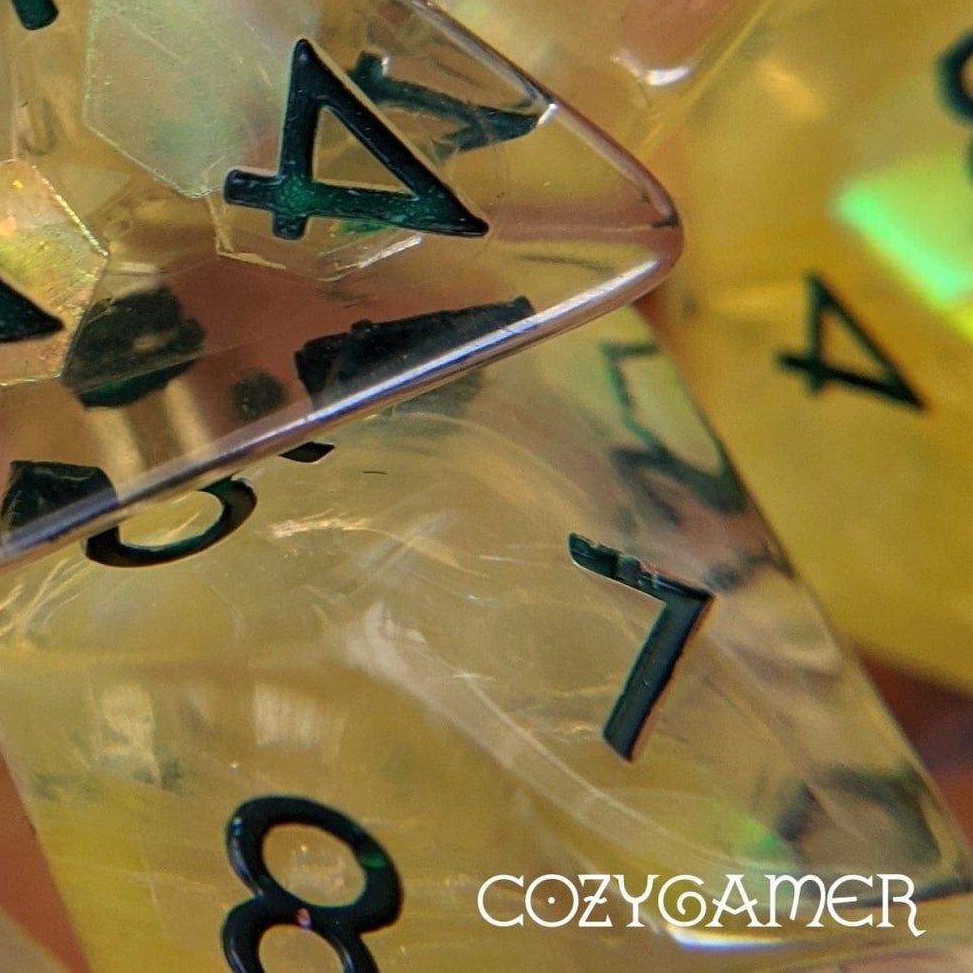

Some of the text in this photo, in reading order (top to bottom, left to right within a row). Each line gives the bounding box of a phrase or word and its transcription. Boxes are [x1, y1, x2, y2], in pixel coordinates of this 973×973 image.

[225, 39, 490, 239] 4
[775, 274, 929, 414] 4
[568, 533, 715, 764] 7
[220, 793, 404, 973] 8
